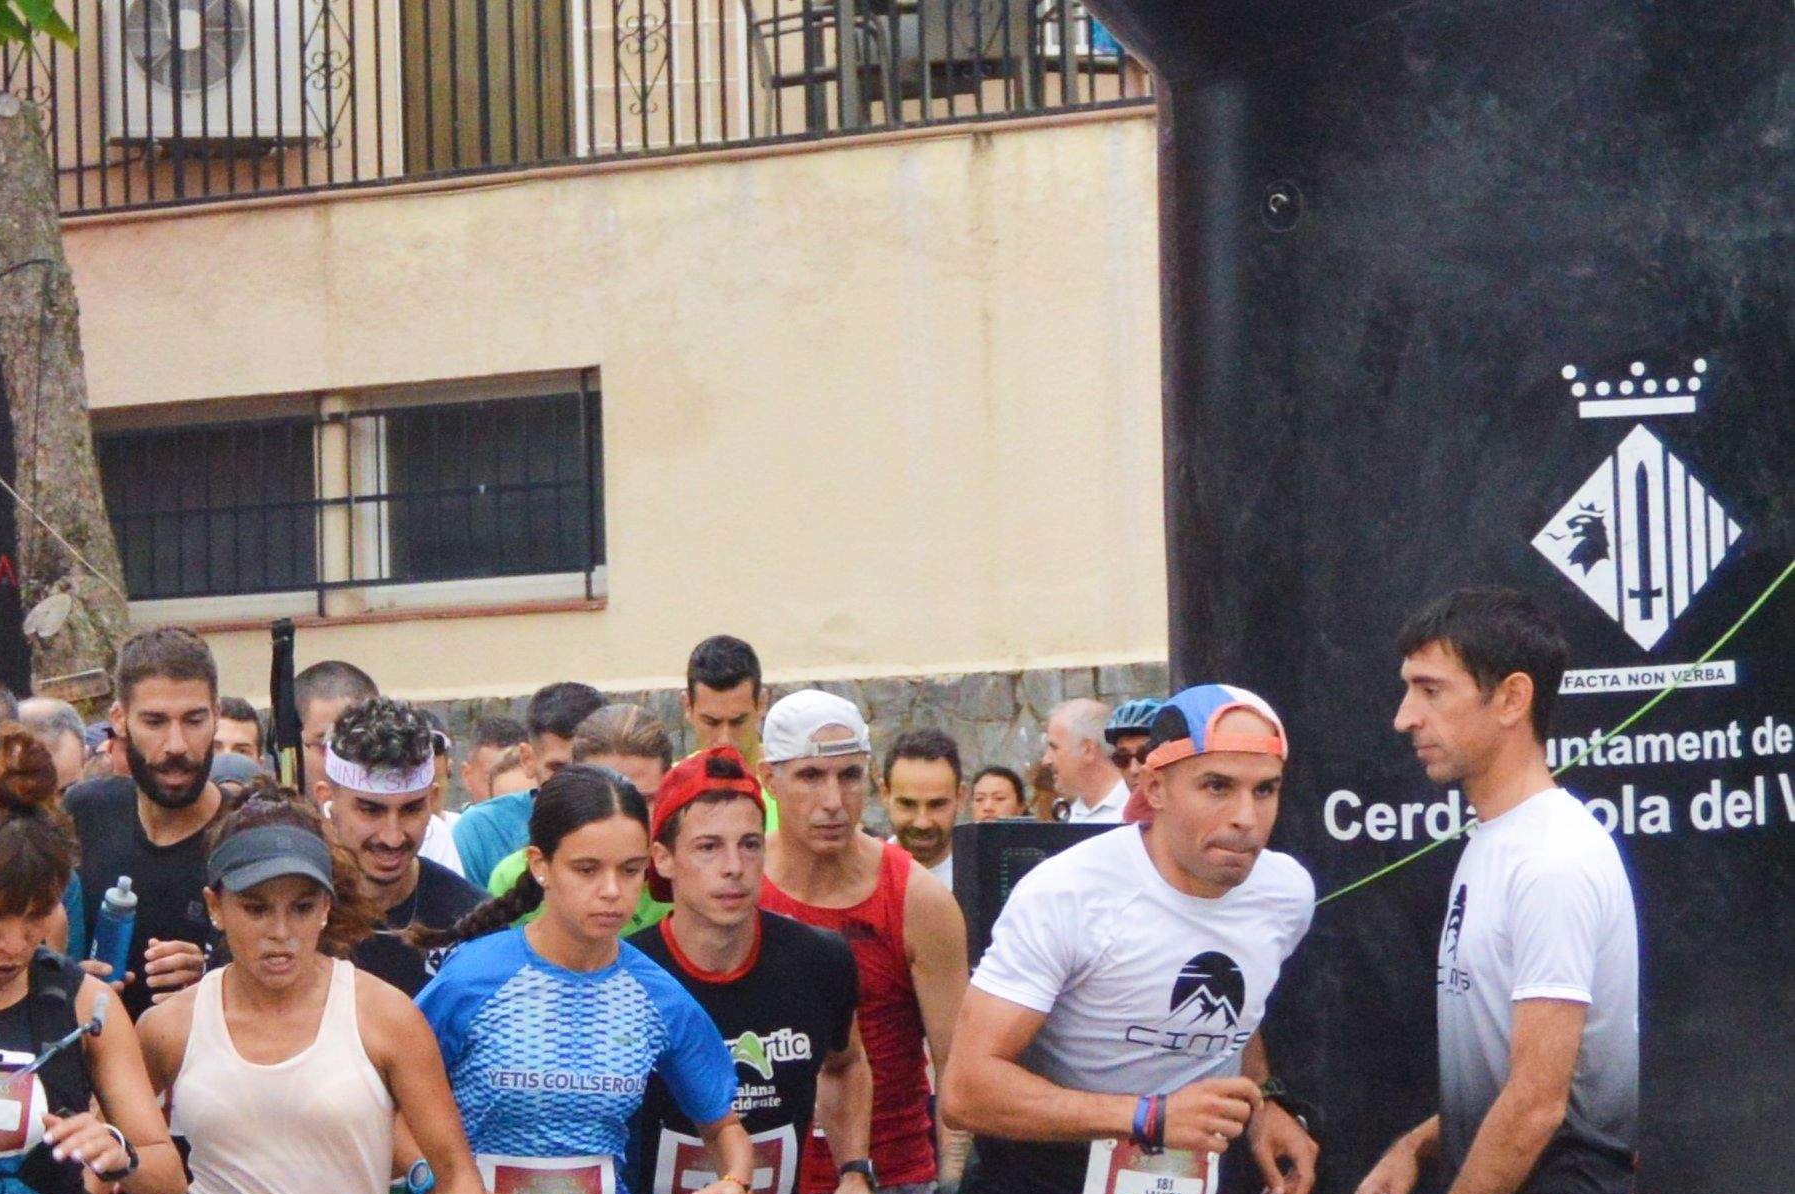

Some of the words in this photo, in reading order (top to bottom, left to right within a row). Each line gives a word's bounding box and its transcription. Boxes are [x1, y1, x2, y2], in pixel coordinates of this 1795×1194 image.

[1564, 673, 1621, 689] FACTA
[1627, 671, 1665, 687] NON
[1671, 667, 1726, 683] VERBA
[1545, 715, 1743, 769] ntament
[1752, 715, 1794, 756] de
[1689, 771, 1767, 830] del
[487, 1070, 540, 1089] YETIS
[1156, 1177, 1174, 1191] 181
